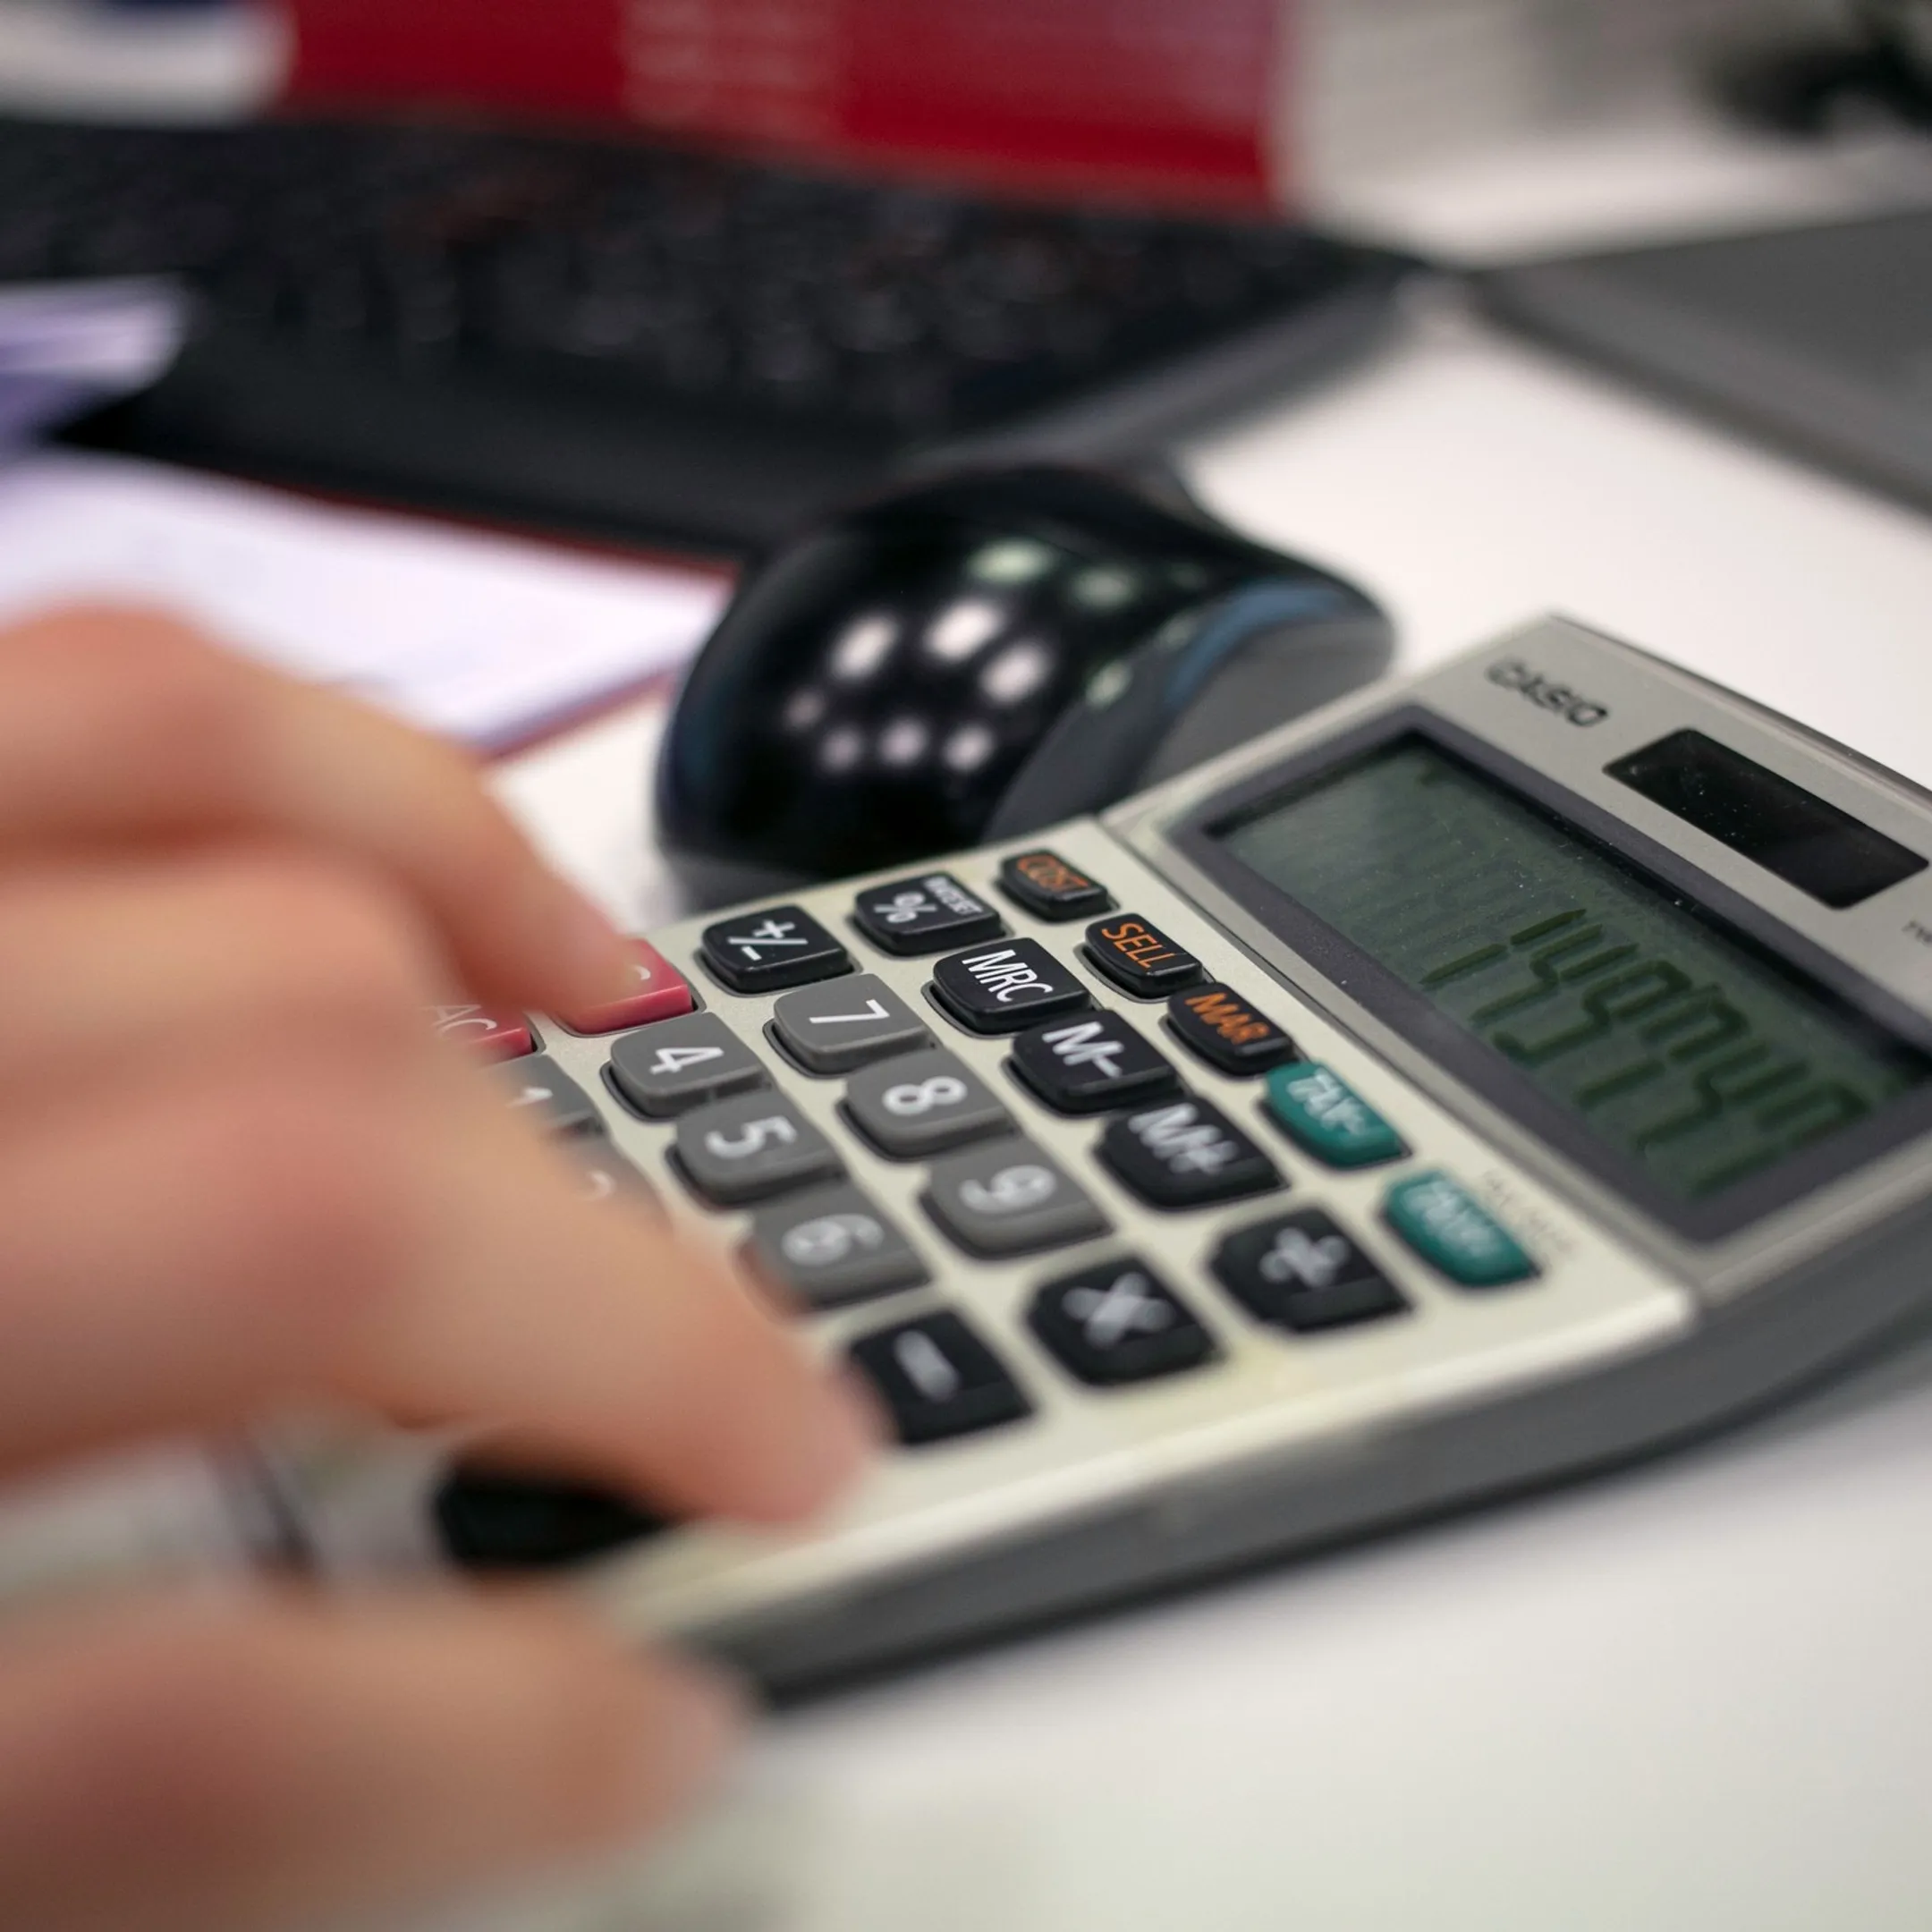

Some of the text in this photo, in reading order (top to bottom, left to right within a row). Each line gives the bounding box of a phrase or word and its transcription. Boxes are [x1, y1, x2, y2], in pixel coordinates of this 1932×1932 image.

[1485, 657, 1610, 729] CASIO
[1101, 921, 1186, 969] SELL
[961, 948, 1055, 1003] MRC
[809, 998, 891, 1024] 7
[1184, 992, 1271, 1045] MAR
[649, 1046, 724, 1074] 4
[1041, 1021, 1125, 1078] M-
[881, 1075, 969, 1116] 8
[705, 1114, 798, 1159] 5
[958, 1164, 1056, 1213] 9
[779, 1212, 886, 1267] 6
